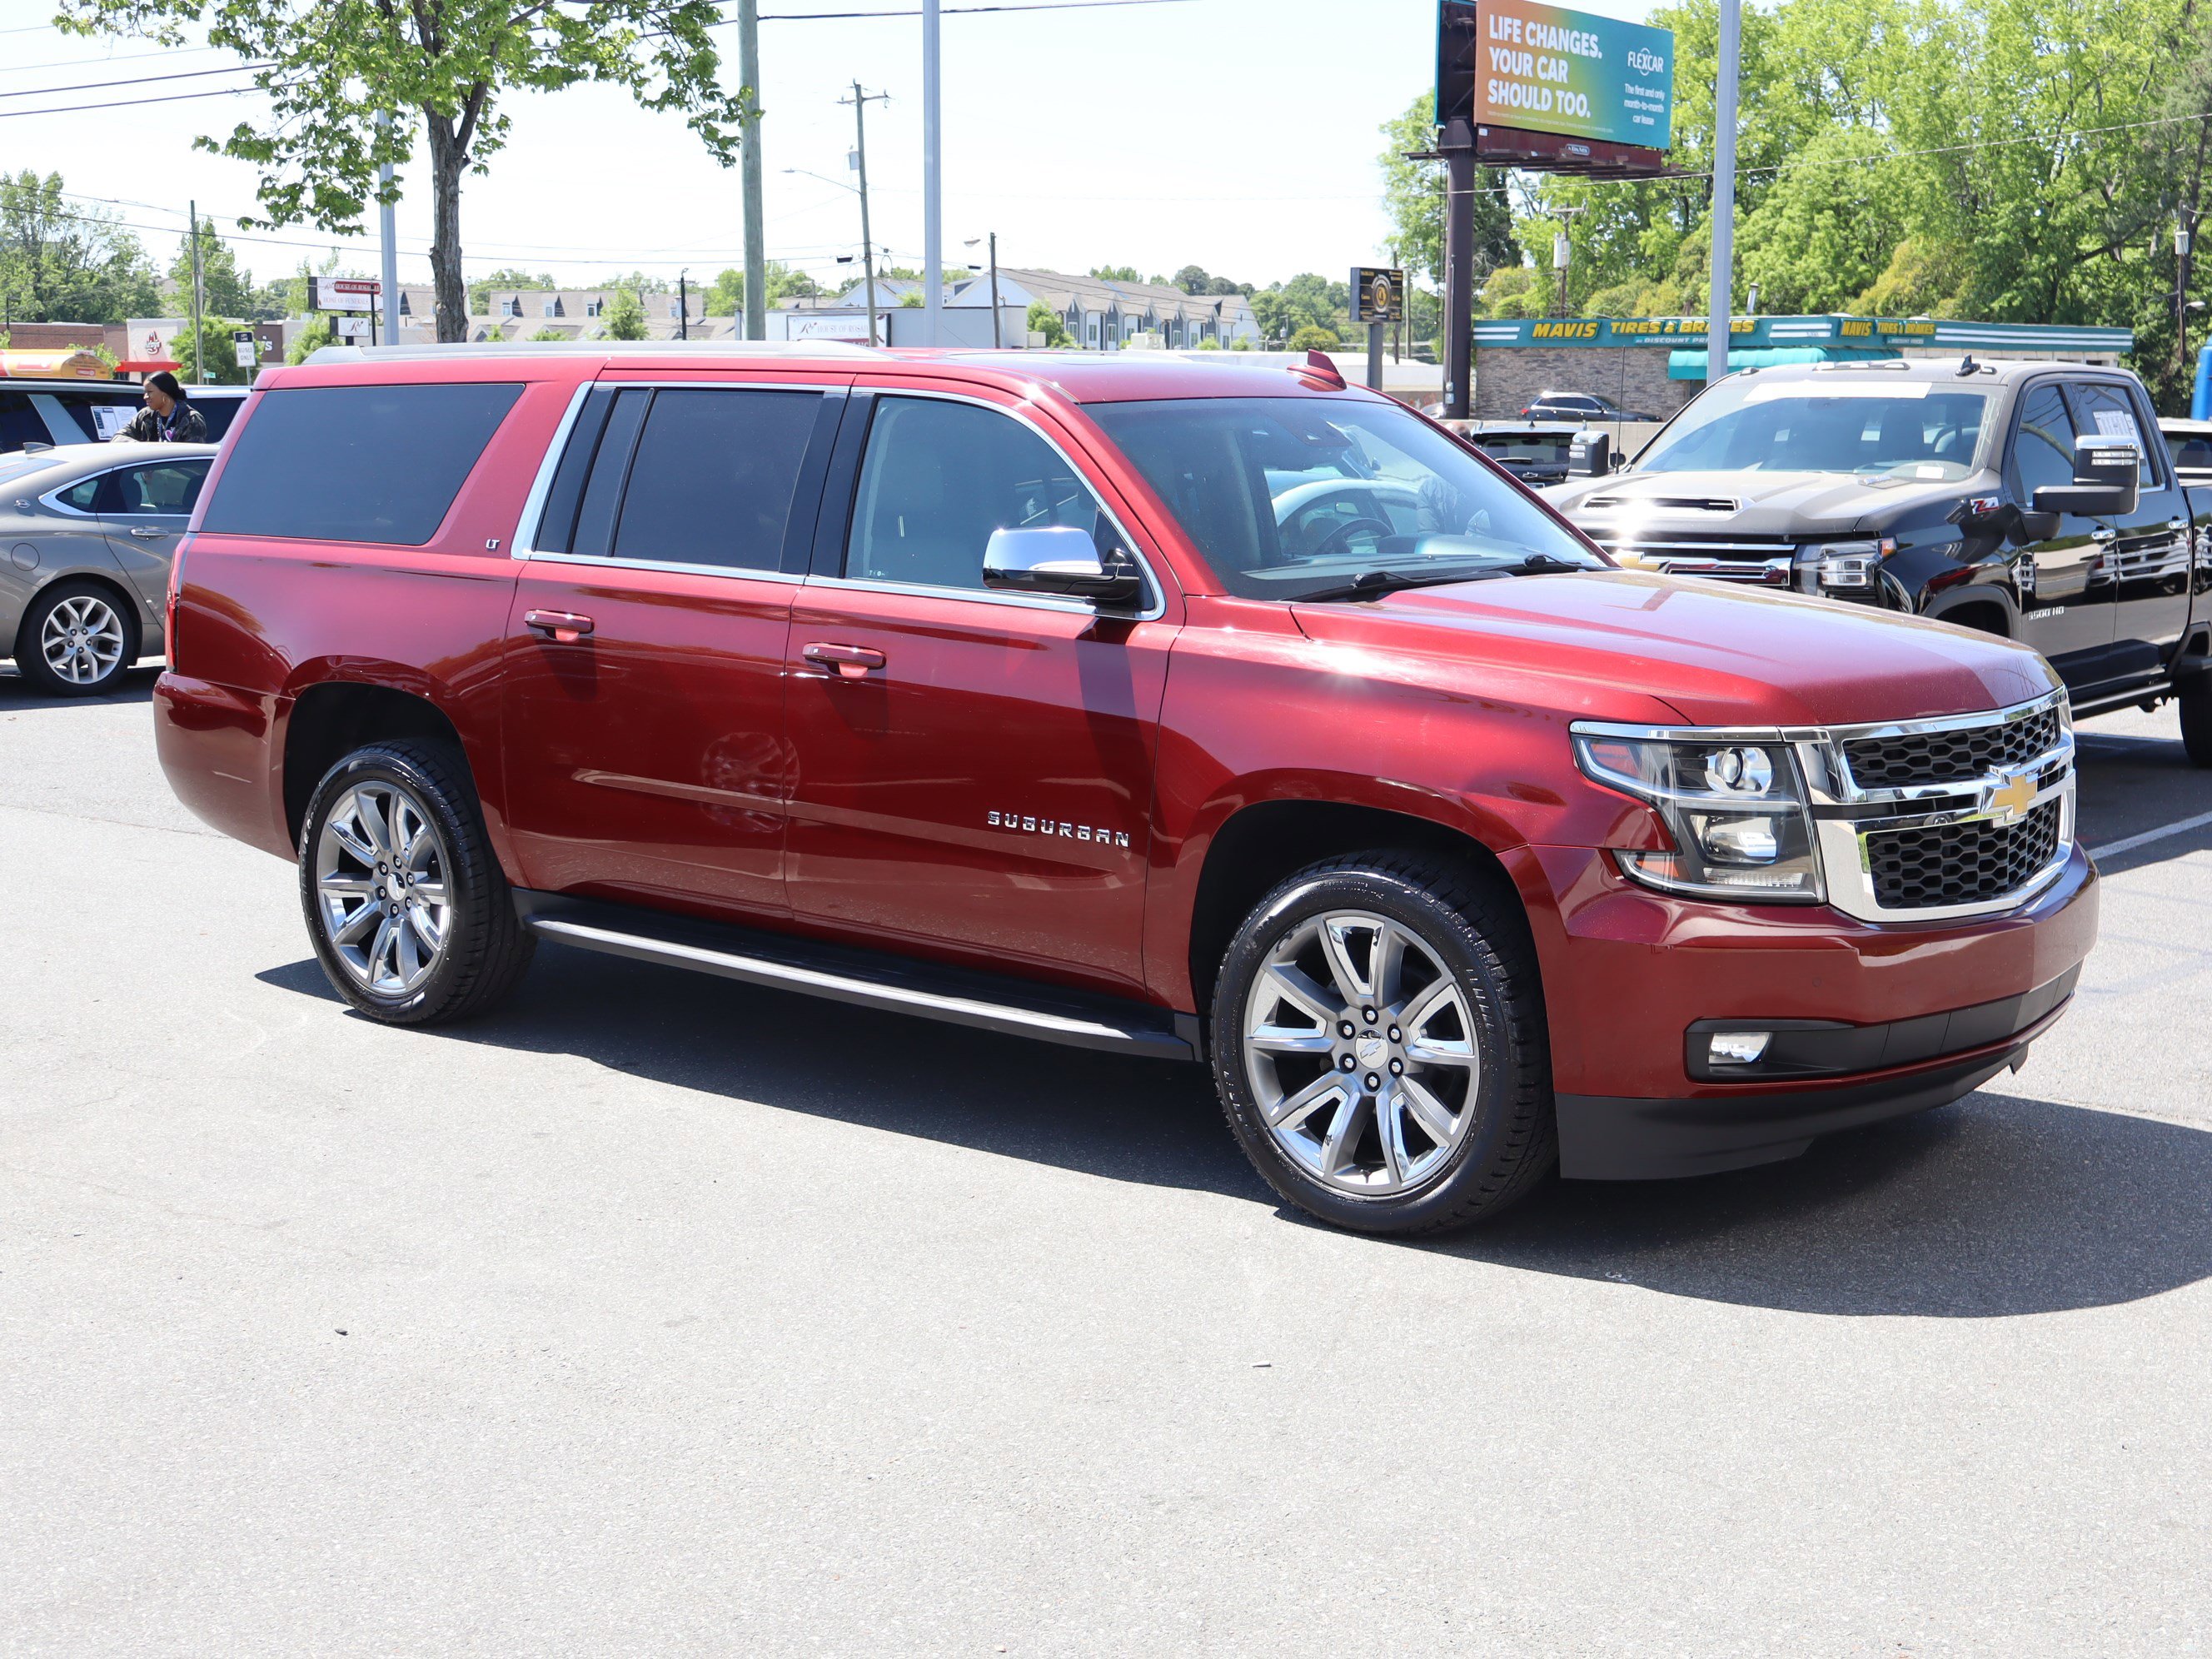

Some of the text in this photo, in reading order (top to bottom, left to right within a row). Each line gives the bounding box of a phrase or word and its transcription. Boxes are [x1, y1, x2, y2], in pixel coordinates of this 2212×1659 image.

[1488, 13, 1603, 59] LIFE CHANGES.
[1488, 47, 1568, 83] YOUR CAR
[1627, 51, 1664, 73] FLEXCAR
[1487, 79, 1592, 118] SHOULD TOO.
[1625, 83, 1635, 94] The
[1645, 88, 1655, 98] and
[1654, 90, 1666, 102] only
[1532, 321, 1755, 337] MAVIS TIRES & BRES
[1841, 321, 1872, 336] MAVIS
[1877, 322, 1898, 333] TIRES
[1906, 323, 1935, 334] BRAKES
[486, 538, 501, 550] LT
[987, 810, 1130, 848] SUBURBAN
